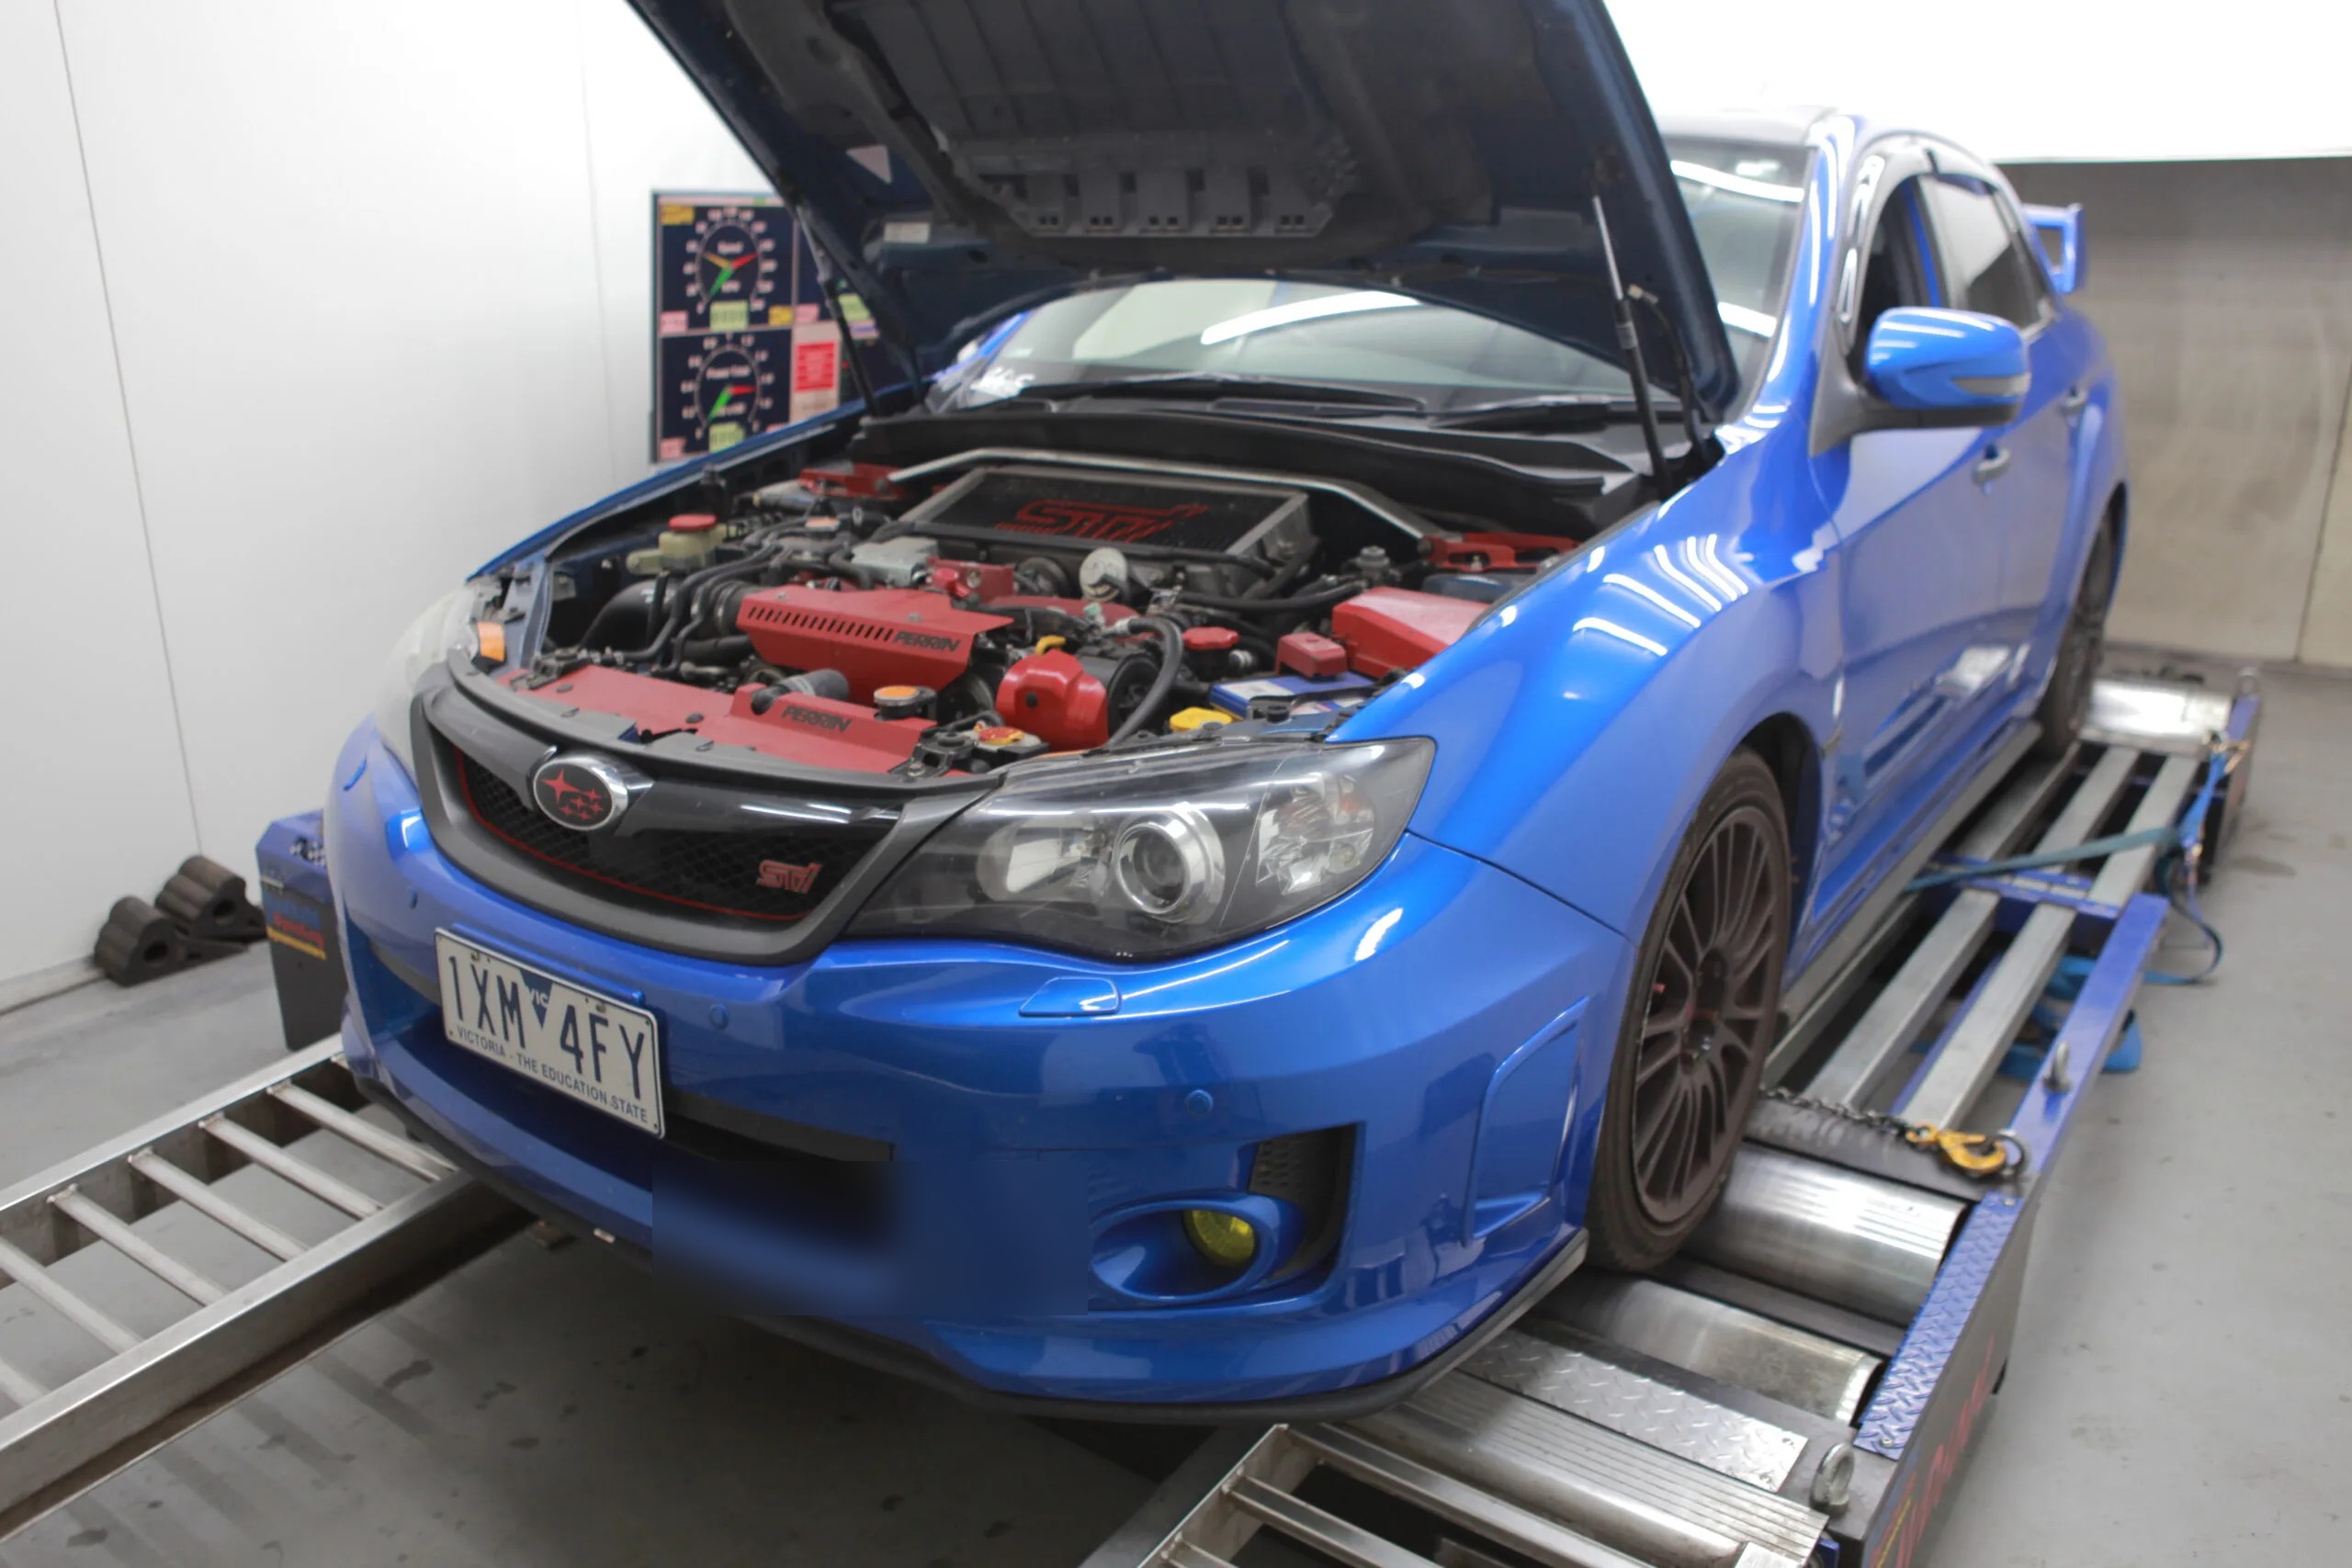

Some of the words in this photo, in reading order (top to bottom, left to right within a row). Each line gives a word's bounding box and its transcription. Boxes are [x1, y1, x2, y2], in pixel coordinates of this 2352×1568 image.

[893, 630, 961, 653] PERRIN
[781, 705, 854, 733] PERRIN
[529, 987, 549, 1009] VIC
[448, 955, 526, 1050] 1XM
[560, 1003, 645, 1100] 4FY
[457, 1026, 506, 1057] VICTORIA
[516, 1052, 538, 1074] THE
[542, 1064, 607, 1105] EDUCATION
[611, 1094, 648, 1123] STATE
